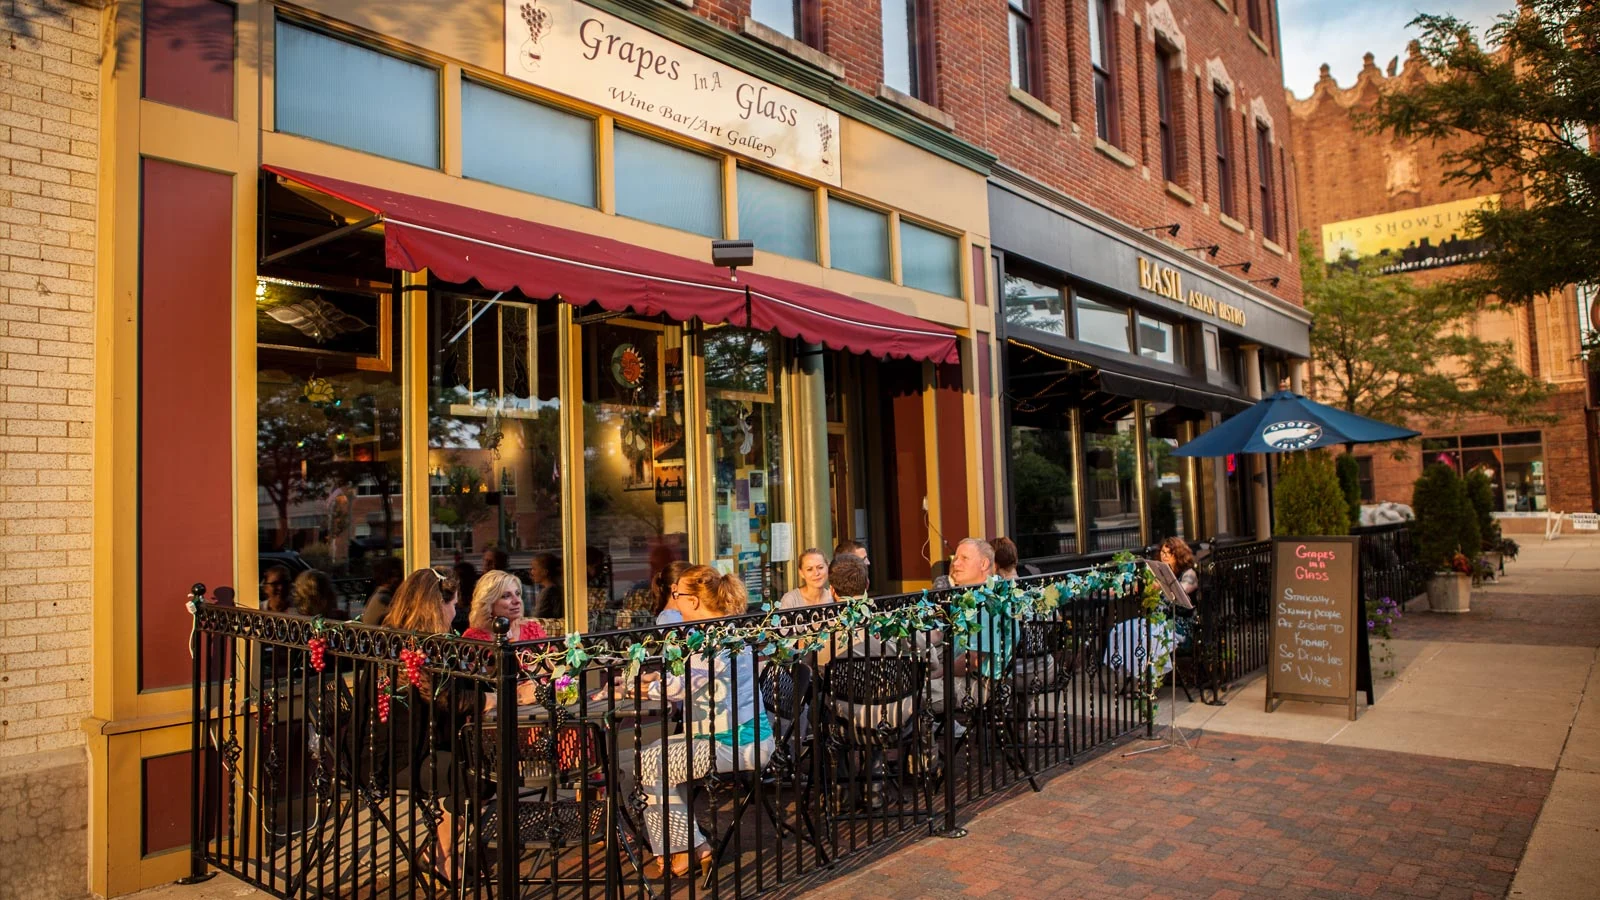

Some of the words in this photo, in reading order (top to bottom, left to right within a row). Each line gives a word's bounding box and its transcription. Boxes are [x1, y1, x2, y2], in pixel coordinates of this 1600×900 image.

[579, 18, 681, 81] Grapes
[711, 71, 723, 92] A
[736, 83, 798, 127] Glass
[608, 85, 655, 113] Wine
[658, 103, 723, 138] Bar/Art
[727, 129, 777, 159] Gallery
[1328, 226, 1363, 242] IT'S
[1374, 209, 1472, 237] SHOWTIM
[1138, 255, 1187, 304] BASIL
[1188, 289, 1217, 316] ASIAN
[1218, 301, 1246, 328] BISTRO
[1270, 421, 1312, 431] GOOSE
[1276, 434, 1318, 449] ISLAND
